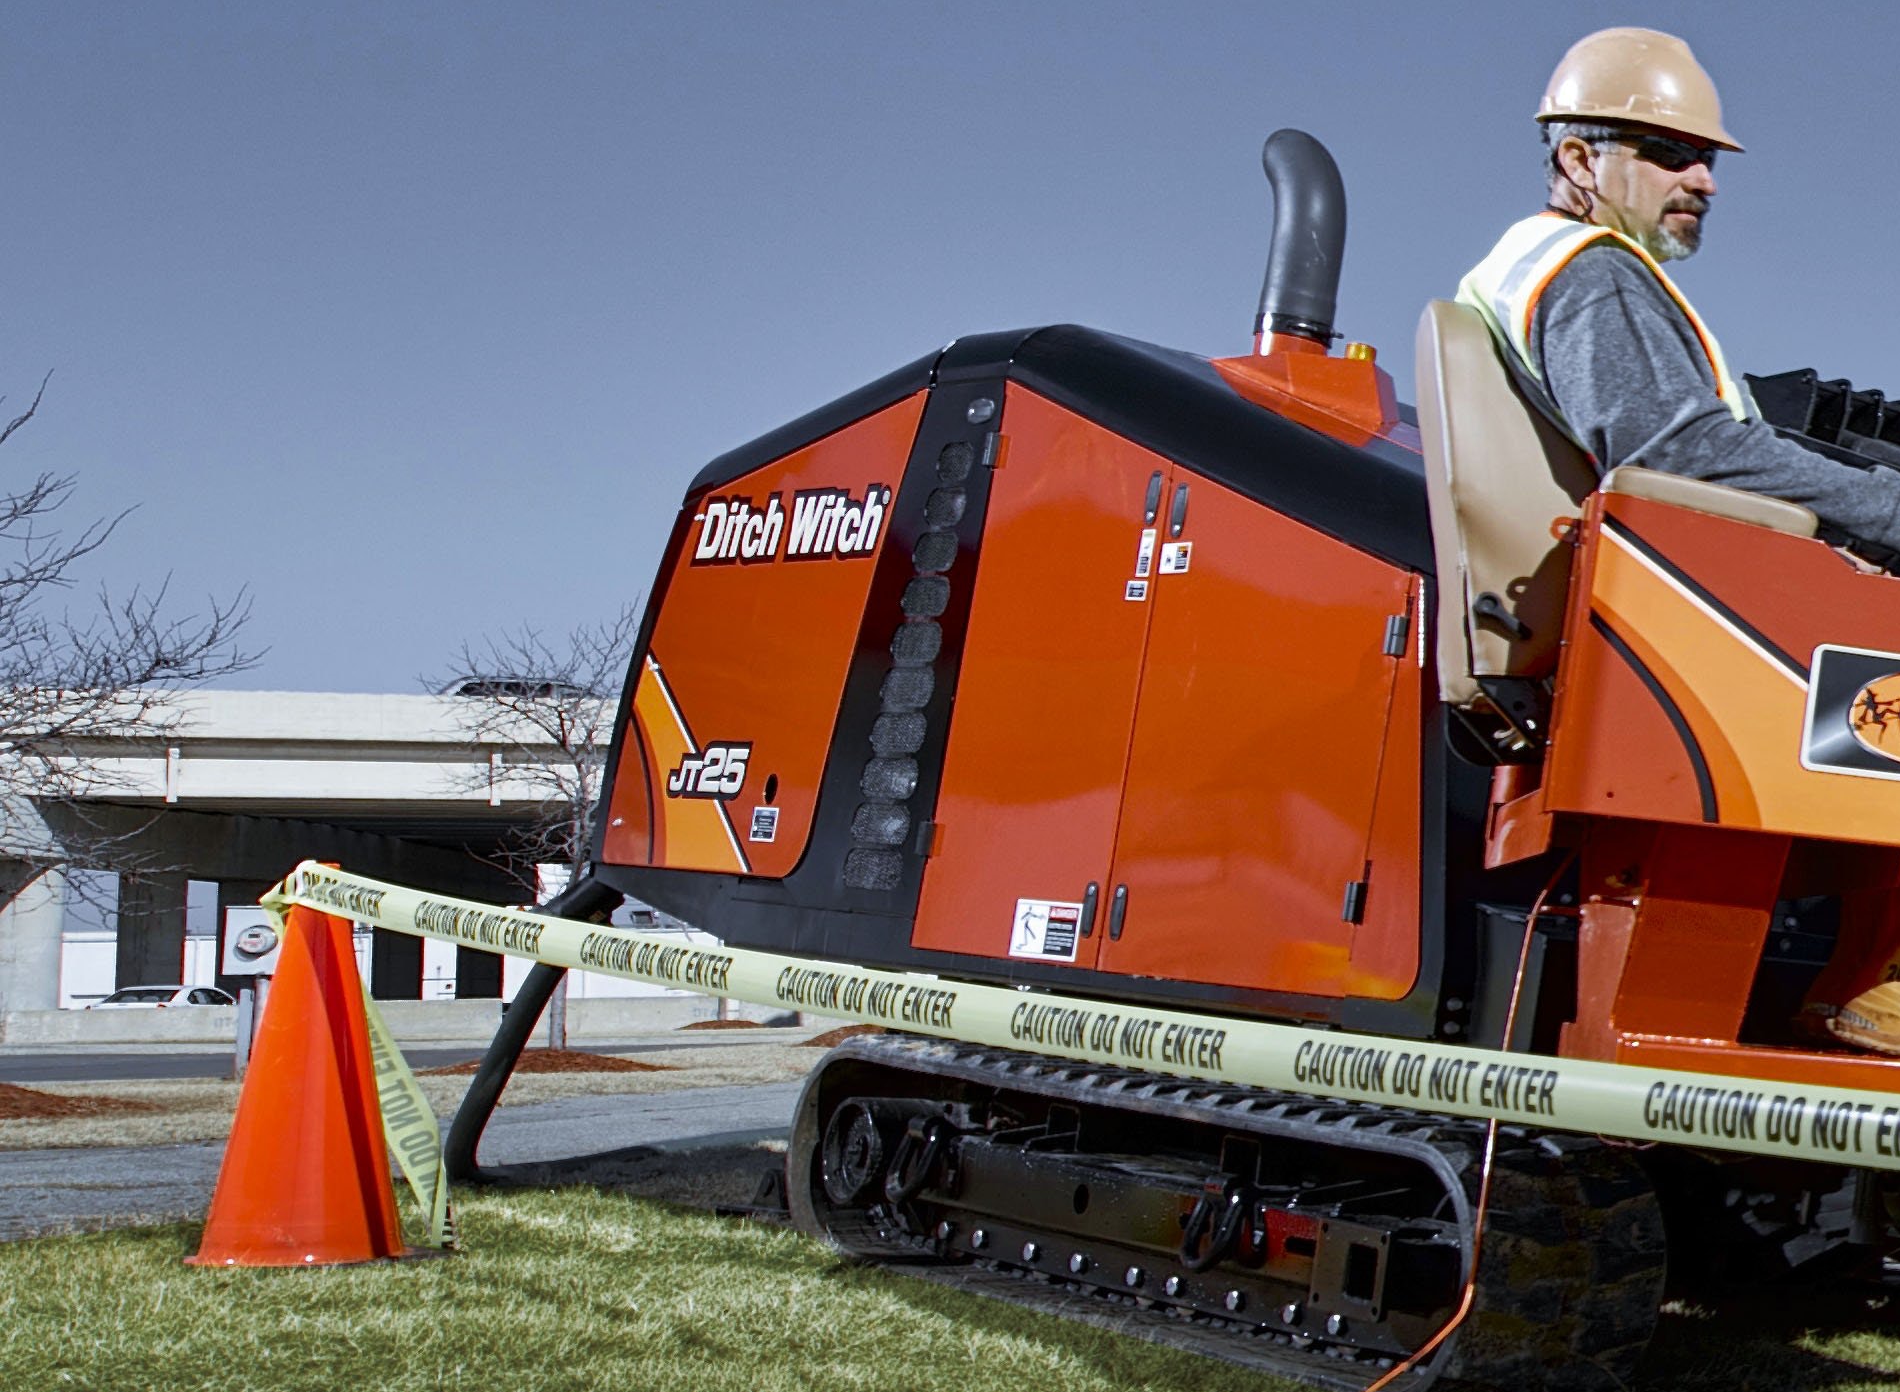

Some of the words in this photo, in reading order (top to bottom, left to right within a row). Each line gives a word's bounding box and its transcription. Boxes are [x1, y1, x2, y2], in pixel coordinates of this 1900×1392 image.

[694, 498, 784, 560] Ditch
[787, 491, 884, 555] Witch
[669, 747, 750, 794] JT25
[414, 900, 464, 937] CAUTION
[461, 909, 480, 942] DO
[479, 913, 506, 946] NOT
[503, 919, 545, 954] ENTER
[580, 932, 640, 971] CAUTION
[636, 943, 660, 976] DO
[656, 946, 689, 982] NOT
[685, 951, 734, 991] ENTER
[776, 966, 845, 1009] CAUTION
[843, 976, 870, 1014] DO
[867, 980, 905, 1019] NOT
[901, 985, 957, 1029] ENTER
[1010, 1002, 1091, 1050] CAUTION
[1090, 1014, 1120, 1055] DO
[1119, 1018, 1163, 1061] NOT
[1161, 1023, 1227, 1072] ENTER
[1294, 1040, 1392, 1093] CAUTION
[1391, 1053, 1427, 1098] DO
[1428, 1057, 1479, 1105] NOT
[1479, 1063, 1559, 1117] ENTER
[1643, 1081, 1764, 1142] CAUTION
[1766, 1095, 1807, 1147] DO
[1811, 1100, 1873, 1153] NOT
